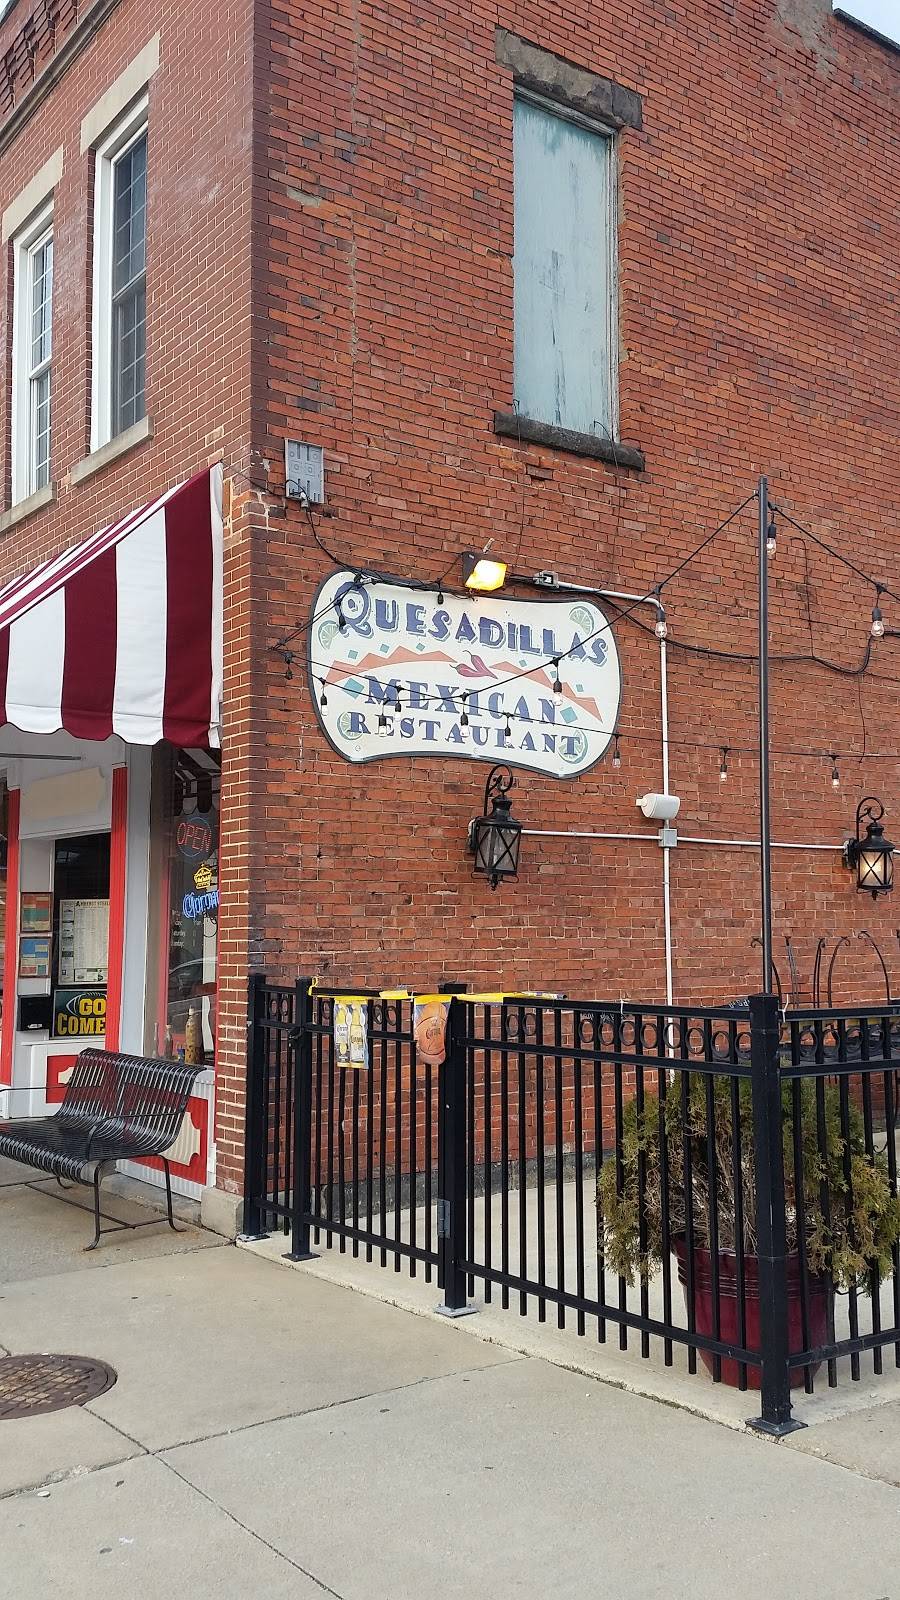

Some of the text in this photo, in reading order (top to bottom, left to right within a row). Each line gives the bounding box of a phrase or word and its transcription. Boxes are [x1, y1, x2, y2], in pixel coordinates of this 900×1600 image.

[334, 581, 608, 667] QUESADILLAS
[364, 675, 557, 726] MEXICAN
[347, 711, 581, 756] RESTAURANT
[177, 822, 211, 853] OPEN
[79, 998, 107, 1016] GO
